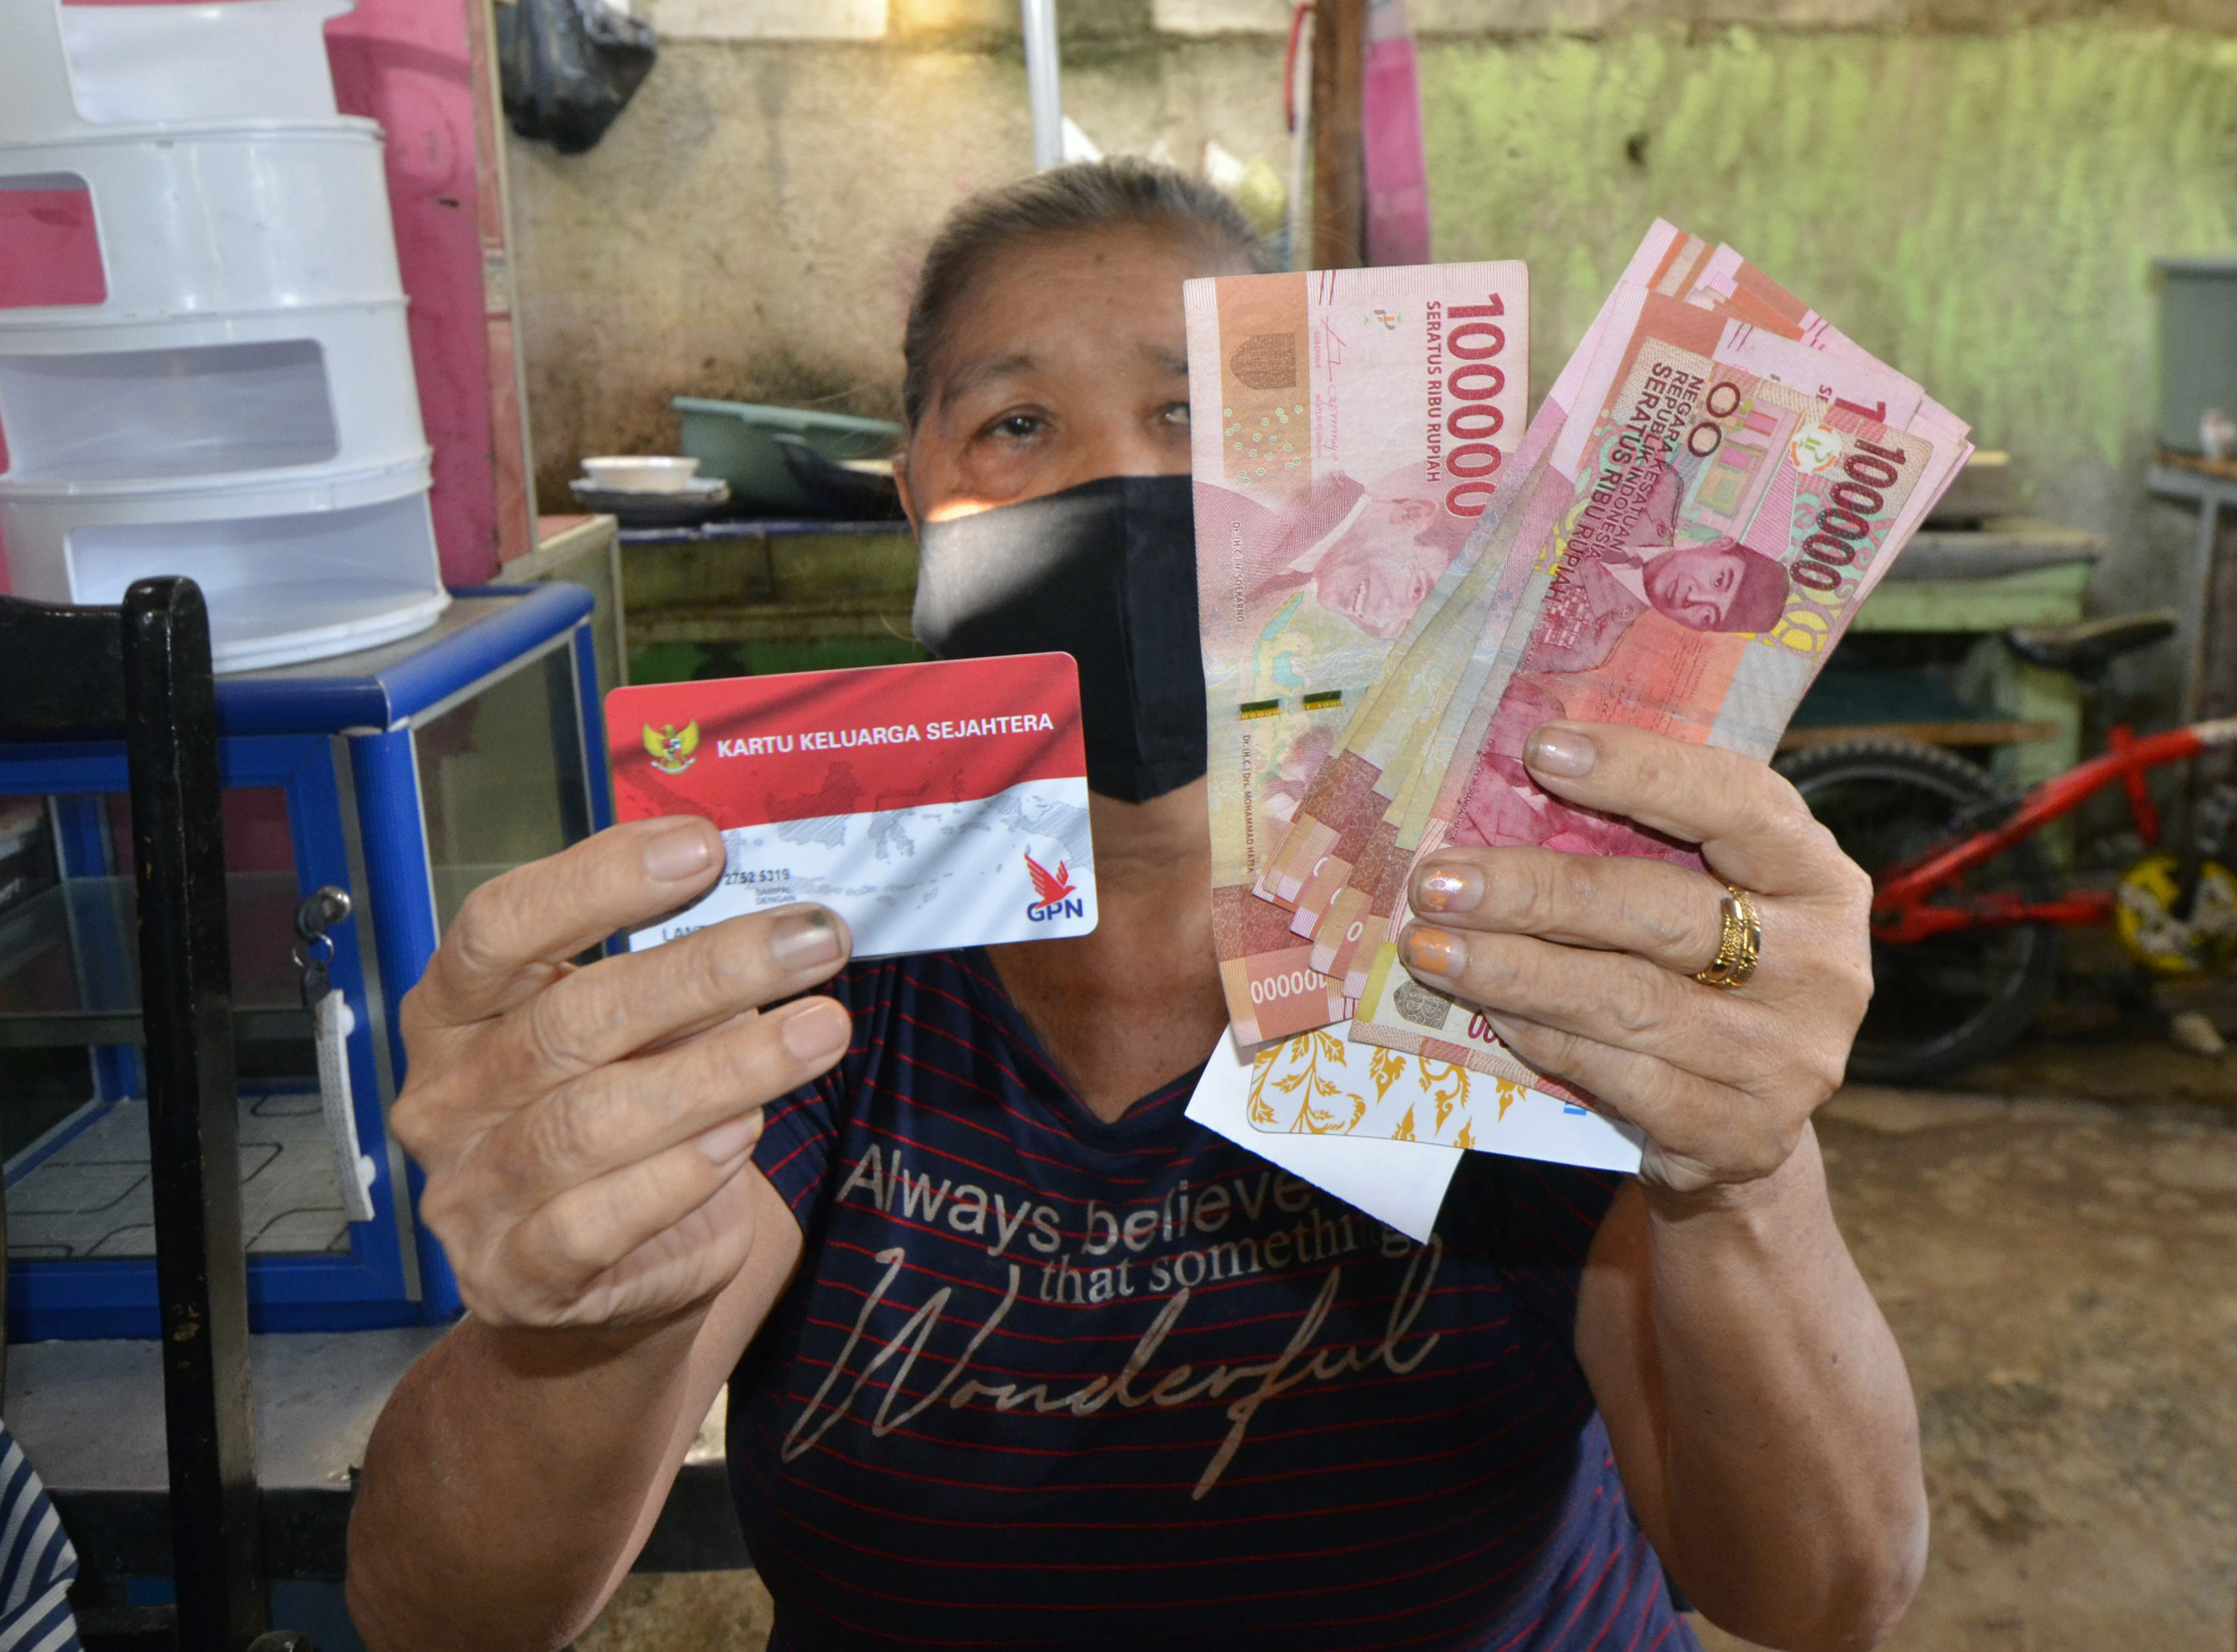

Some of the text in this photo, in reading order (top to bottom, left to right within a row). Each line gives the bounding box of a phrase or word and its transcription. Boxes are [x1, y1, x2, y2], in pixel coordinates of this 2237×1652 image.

[1426, 300, 1443, 483] SERATUS RIBU RUPIAH
[1444, 292, 1506, 518] 100000
[1586, 369, 1689, 562] REPUBLIK INDONESIA
[1609, 375, 1704, 553] NEGARA KESATUAN
[1543, 361, 1673, 605] SERATUS RIBU RUPIAH
[1790, 439, 1906, 591] 100000
[1234, 575, 1244, 622] SOEKARNO
[717, 713, 1054, 758] KARTU KELUARGA SEJAHTERA
[1244, 791, 1253, 845] MOHAMMAD
[1026, 898, 1083, 922] GPN
[838, 1142, 1312, 1258] Always believe
[1040, 1253, 1134, 1305] that
[782, 1233, 1442, 1501] Wonderful
